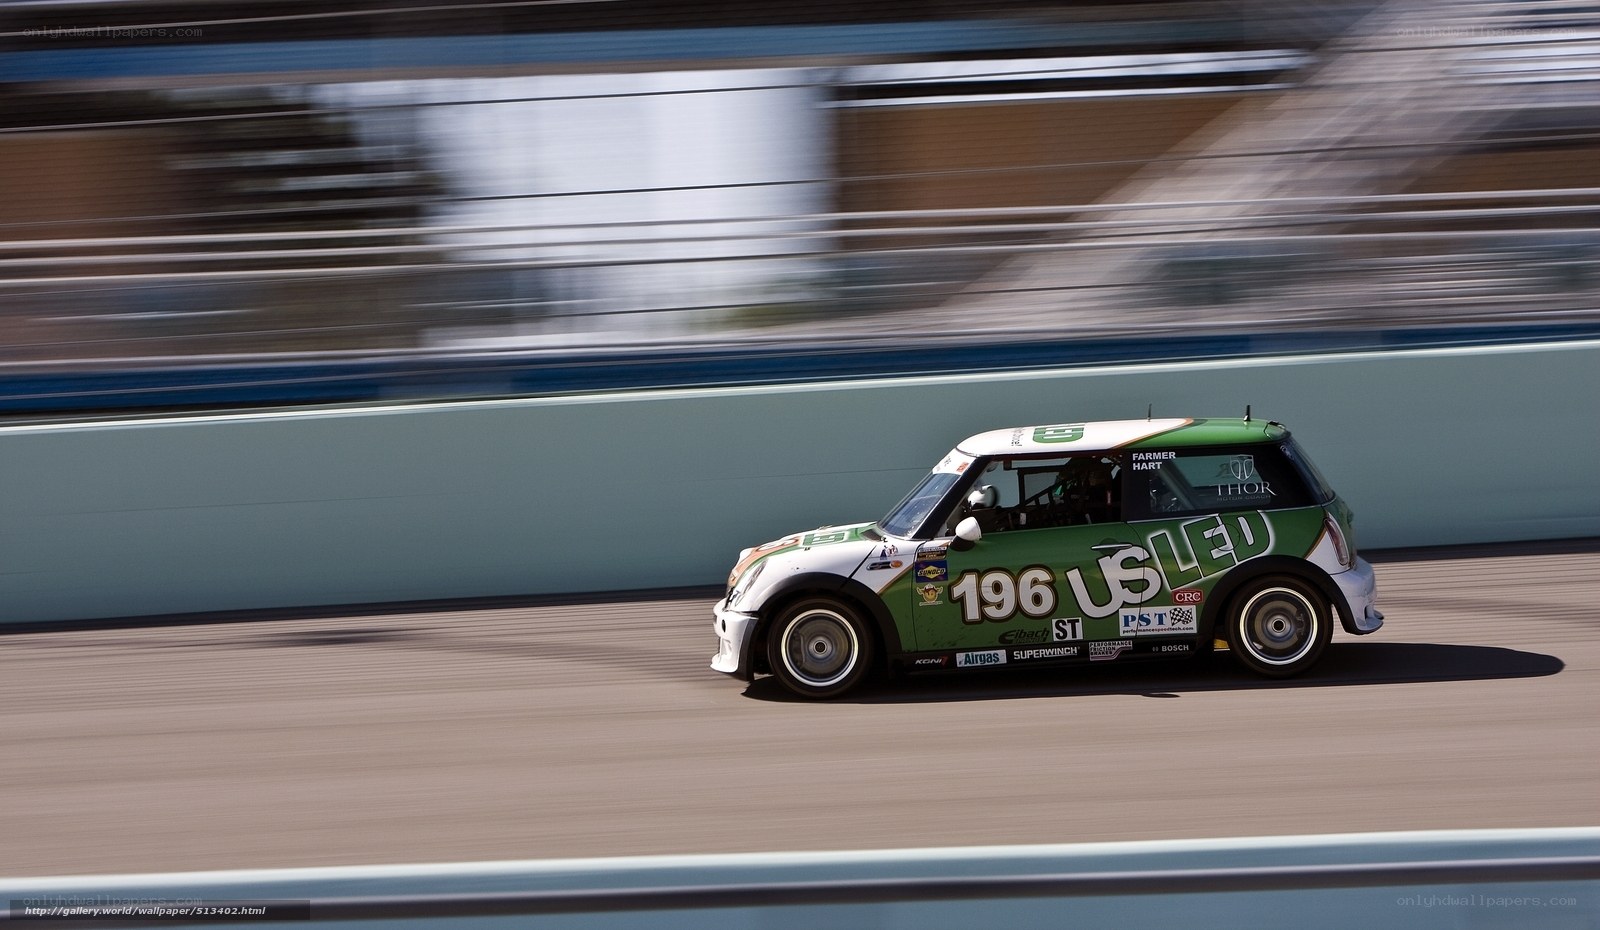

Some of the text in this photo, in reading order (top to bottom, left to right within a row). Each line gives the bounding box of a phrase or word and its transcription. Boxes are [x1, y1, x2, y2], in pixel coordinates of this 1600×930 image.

[1132, 452, 1176, 461] FARMER
[1132, 462, 1162, 470] HART
[1209, 481, 1277, 496] THOR
[918, 568, 945, 577] SUNOCO
[950, 566, 1056, 622] 196
[1176, 592, 1201, 602] CRC
[1122, 612, 1167, 628] PST
[998, 627, 1050, 644] Eibach
[1054, 619, 1080, 640] ST
[1122, 626, 1194, 635] performancespeedtech.com
[963, 652, 1000, 665] Airgas
[1014, 647, 1078, 660] SUPERWINCH
